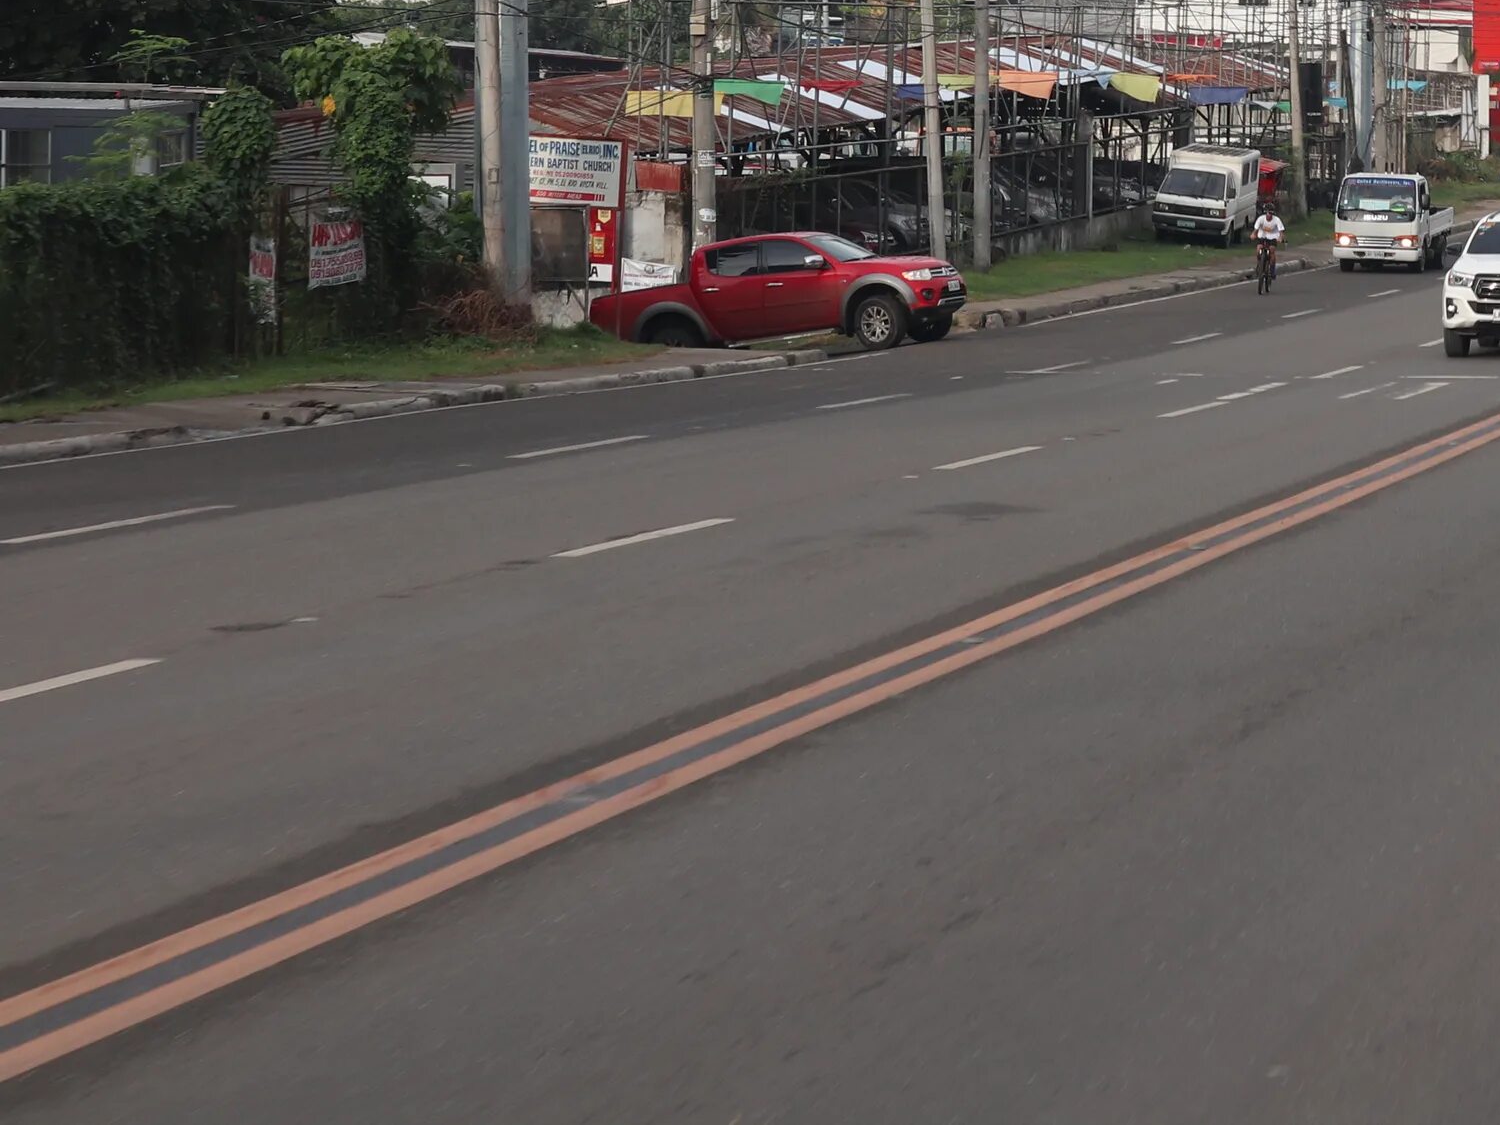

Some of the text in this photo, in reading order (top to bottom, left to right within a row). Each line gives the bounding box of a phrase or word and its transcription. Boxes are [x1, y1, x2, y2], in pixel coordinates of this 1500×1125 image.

[529, 139, 538, 154] EL
[539, 142, 549, 152] OF
[549, 141, 580, 156] PRAISE
[530, 156, 544, 167] ERN
[547, 158, 579, 170] BAPTIST
